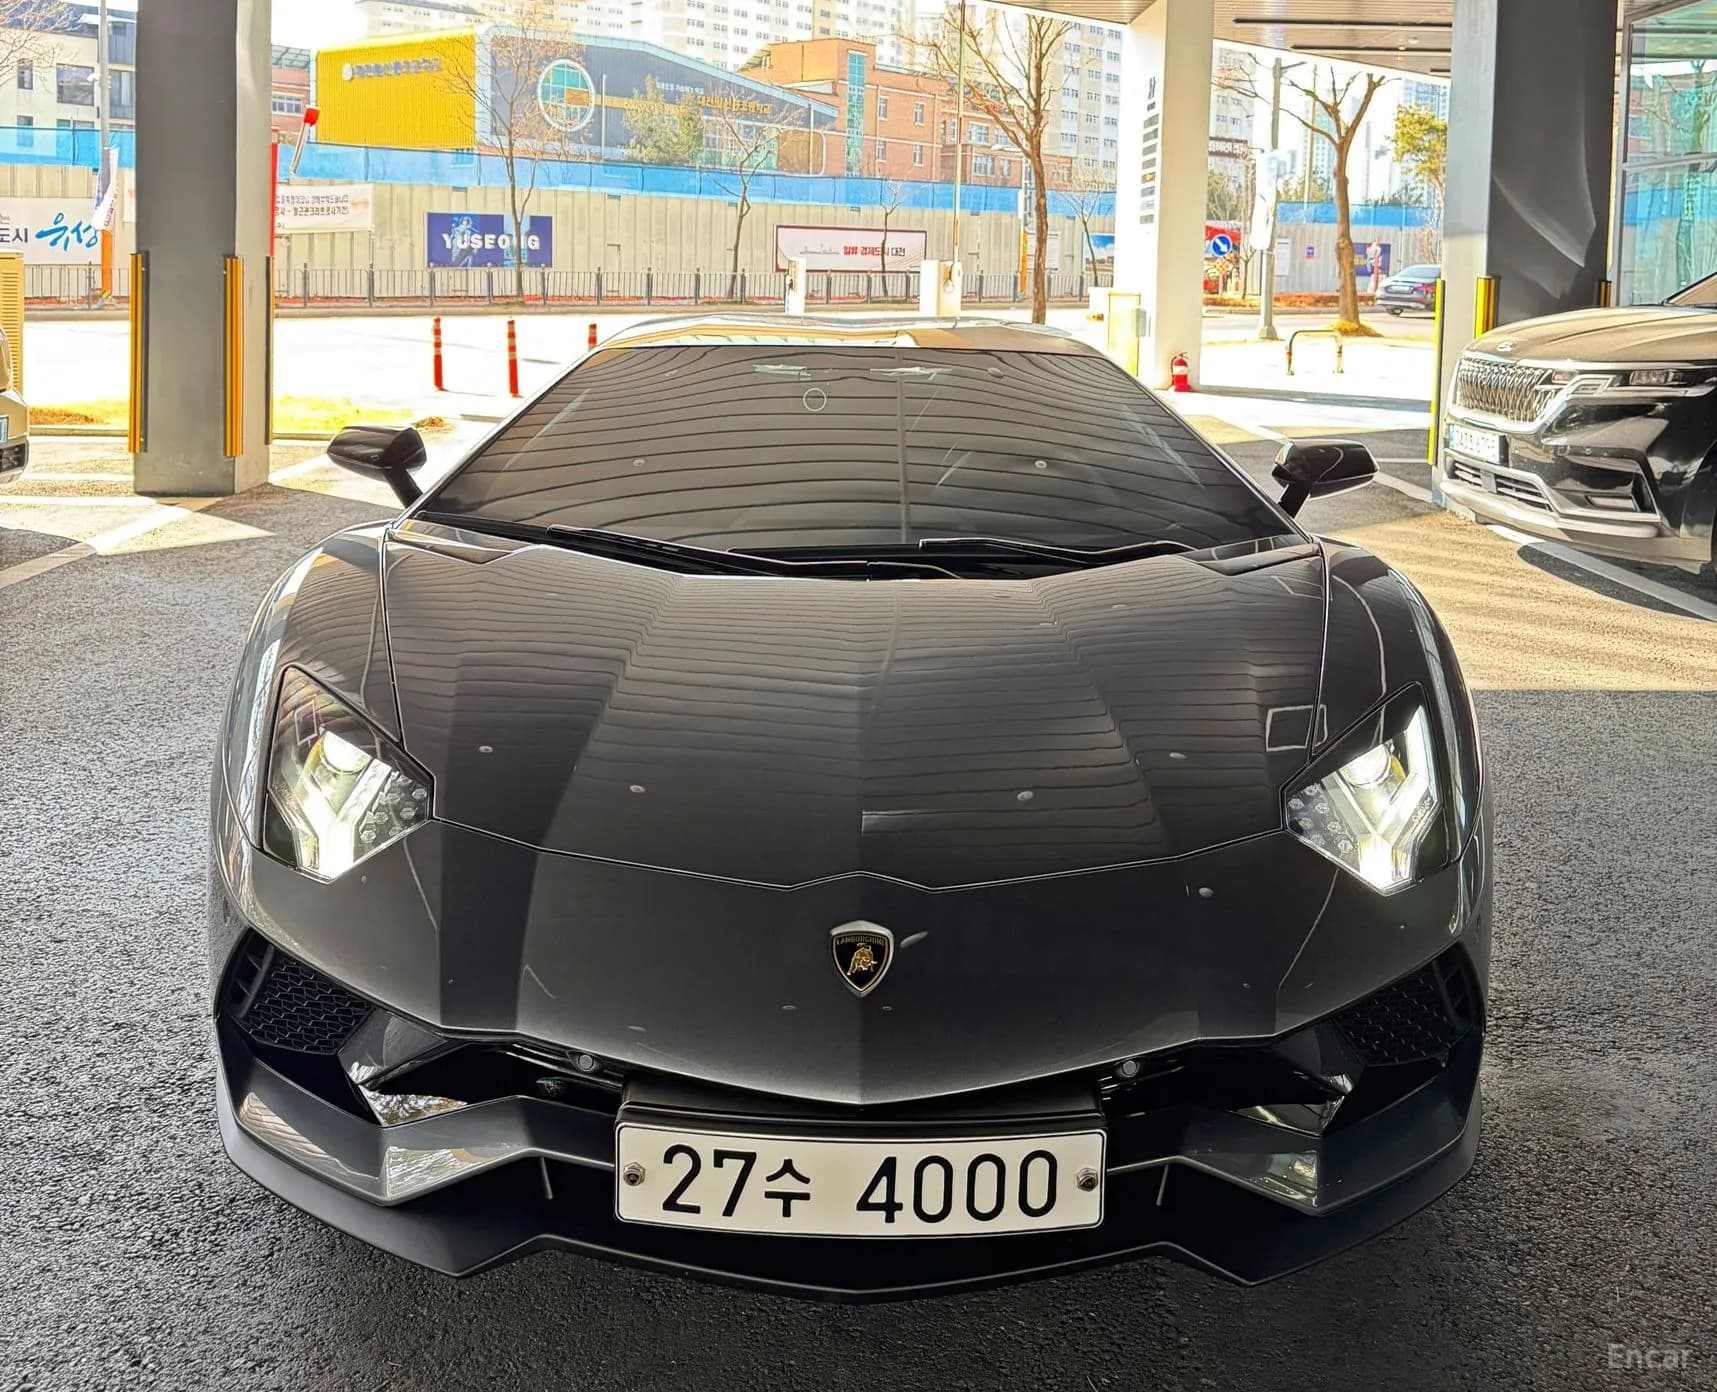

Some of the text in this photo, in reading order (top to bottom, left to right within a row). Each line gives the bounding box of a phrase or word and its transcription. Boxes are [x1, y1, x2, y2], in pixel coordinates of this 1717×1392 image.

[891, 247, 906, 257] 대전
[836, 935, 885, 947] LAMBORGHINI
[662, 1144, 1058, 1223] 27수 4000
